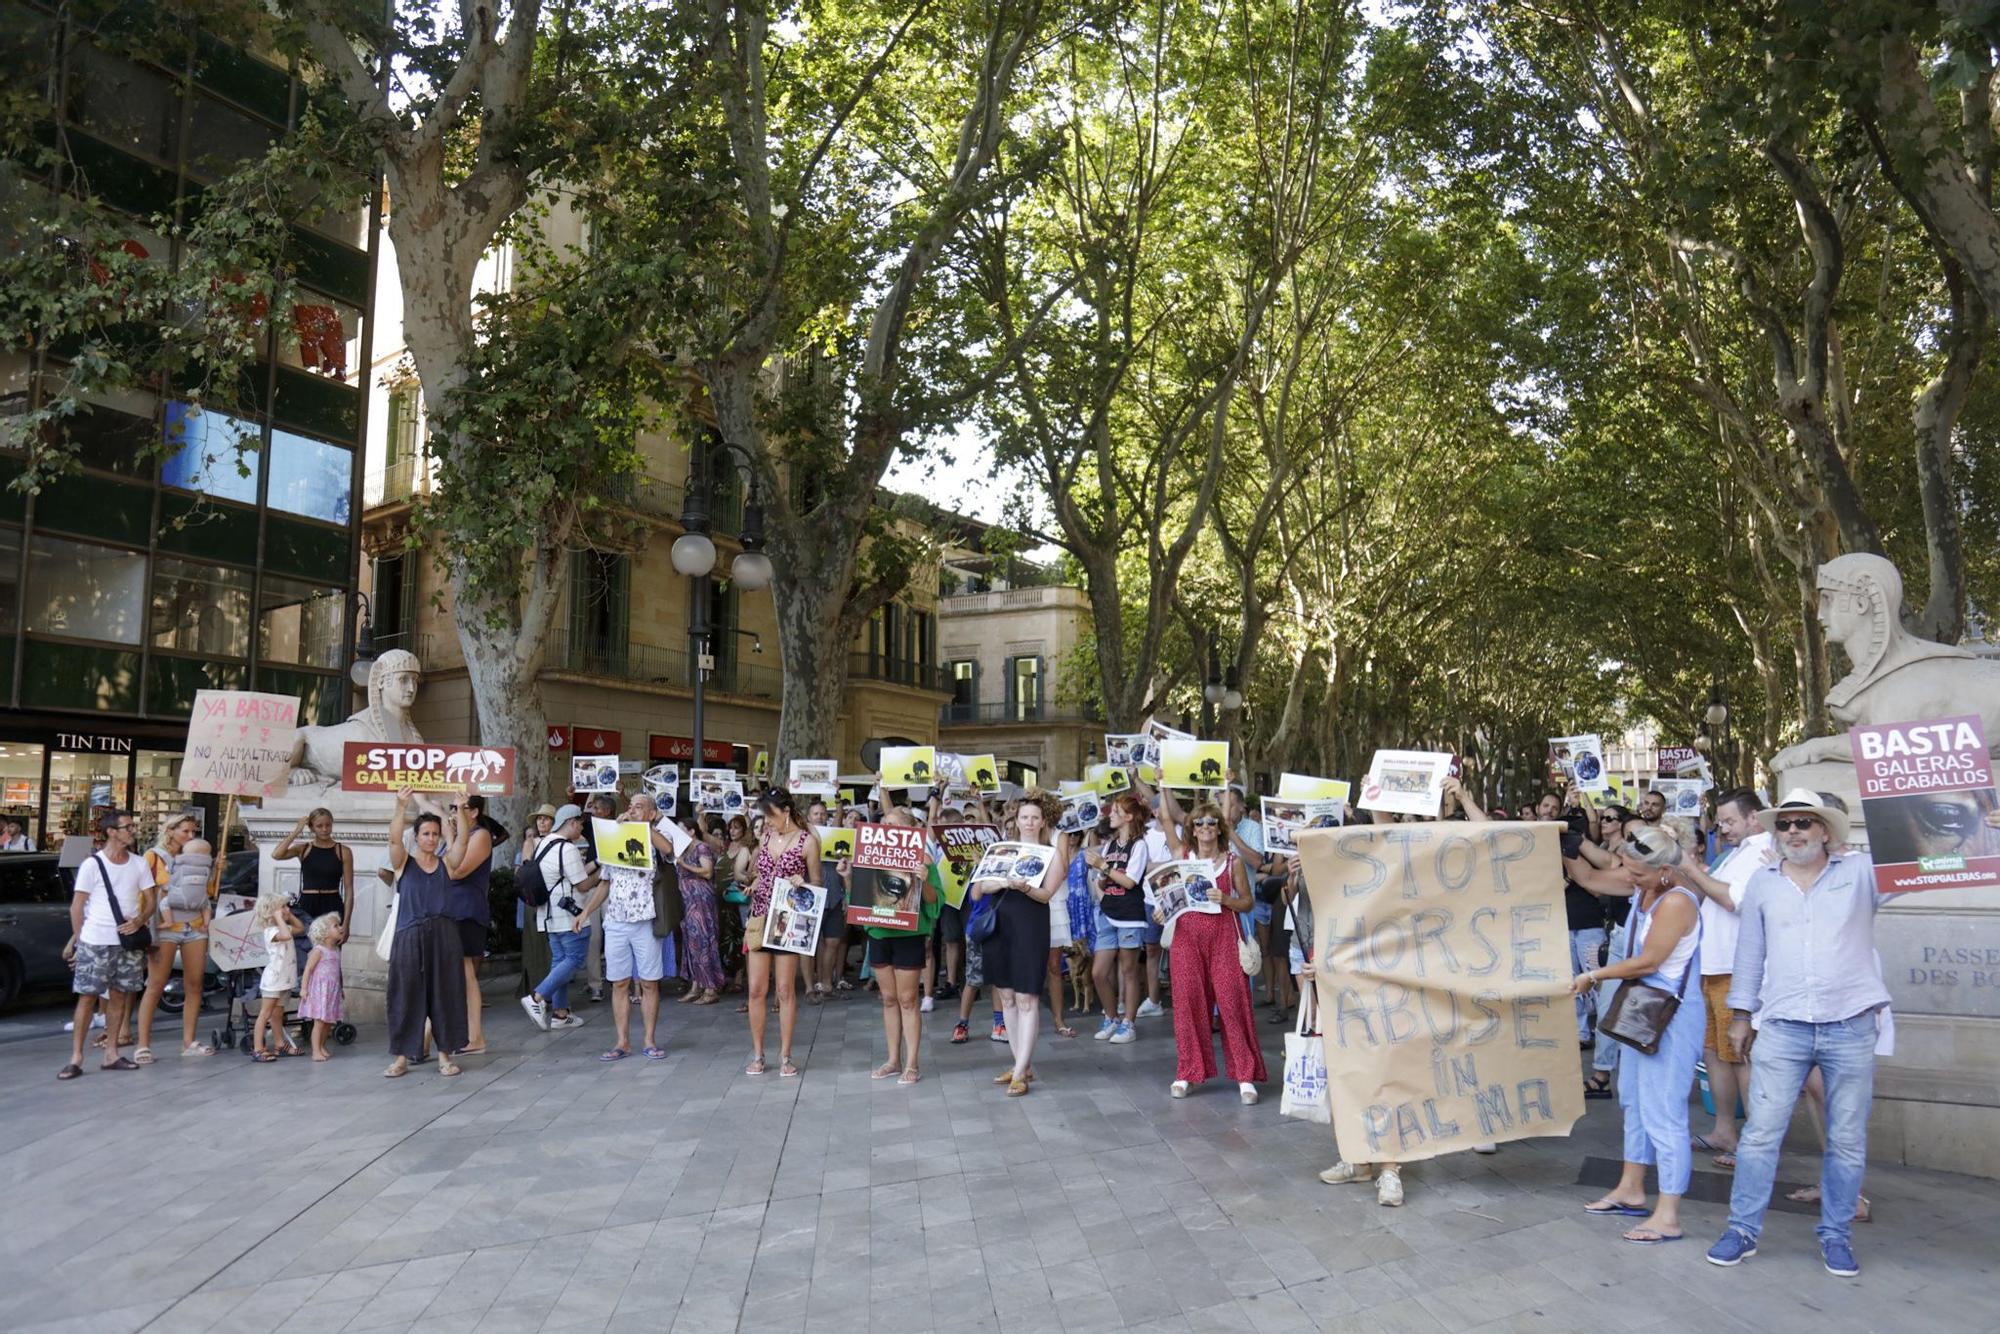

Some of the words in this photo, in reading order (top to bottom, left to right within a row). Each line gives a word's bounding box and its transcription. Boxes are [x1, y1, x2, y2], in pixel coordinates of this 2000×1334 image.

[201, 697, 228, 722] YA
[236, 696, 294, 724] BASTA
[57, 733, 93, 749] TIN
[97, 736, 132, 752] TIN
[194, 745, 212, 759] NO
[1859, 722, 1982, 760] BASTA
[1659, 748, 1695, 760] BASTA
[1873, 752, 1975, 777] GALERAS
[204, 761, 265, 783] ANIMAL
[355, 769, 446, 785] GALERAS
[1866, 777, 1892, 793] DE
[1894, 769, 1988, 791] CABALLOS
[860, 826, 923, 849] BASTA
[857, 854, 871, 865] DE
[872, 857, 922, 870] CABALLOS
[864, 845, 917, 860] GALERAS
[1335, 828, 1536, 899] STOP
[1325, 903, 1558, 982] HORSE
[1910, 968, 1960, 986] DES
[1335, 985, 1559, 1049] ABUSE
[1431, 1048, 1480, 1098] IN
[1361, 1078, 1555, 1154] PALMA
